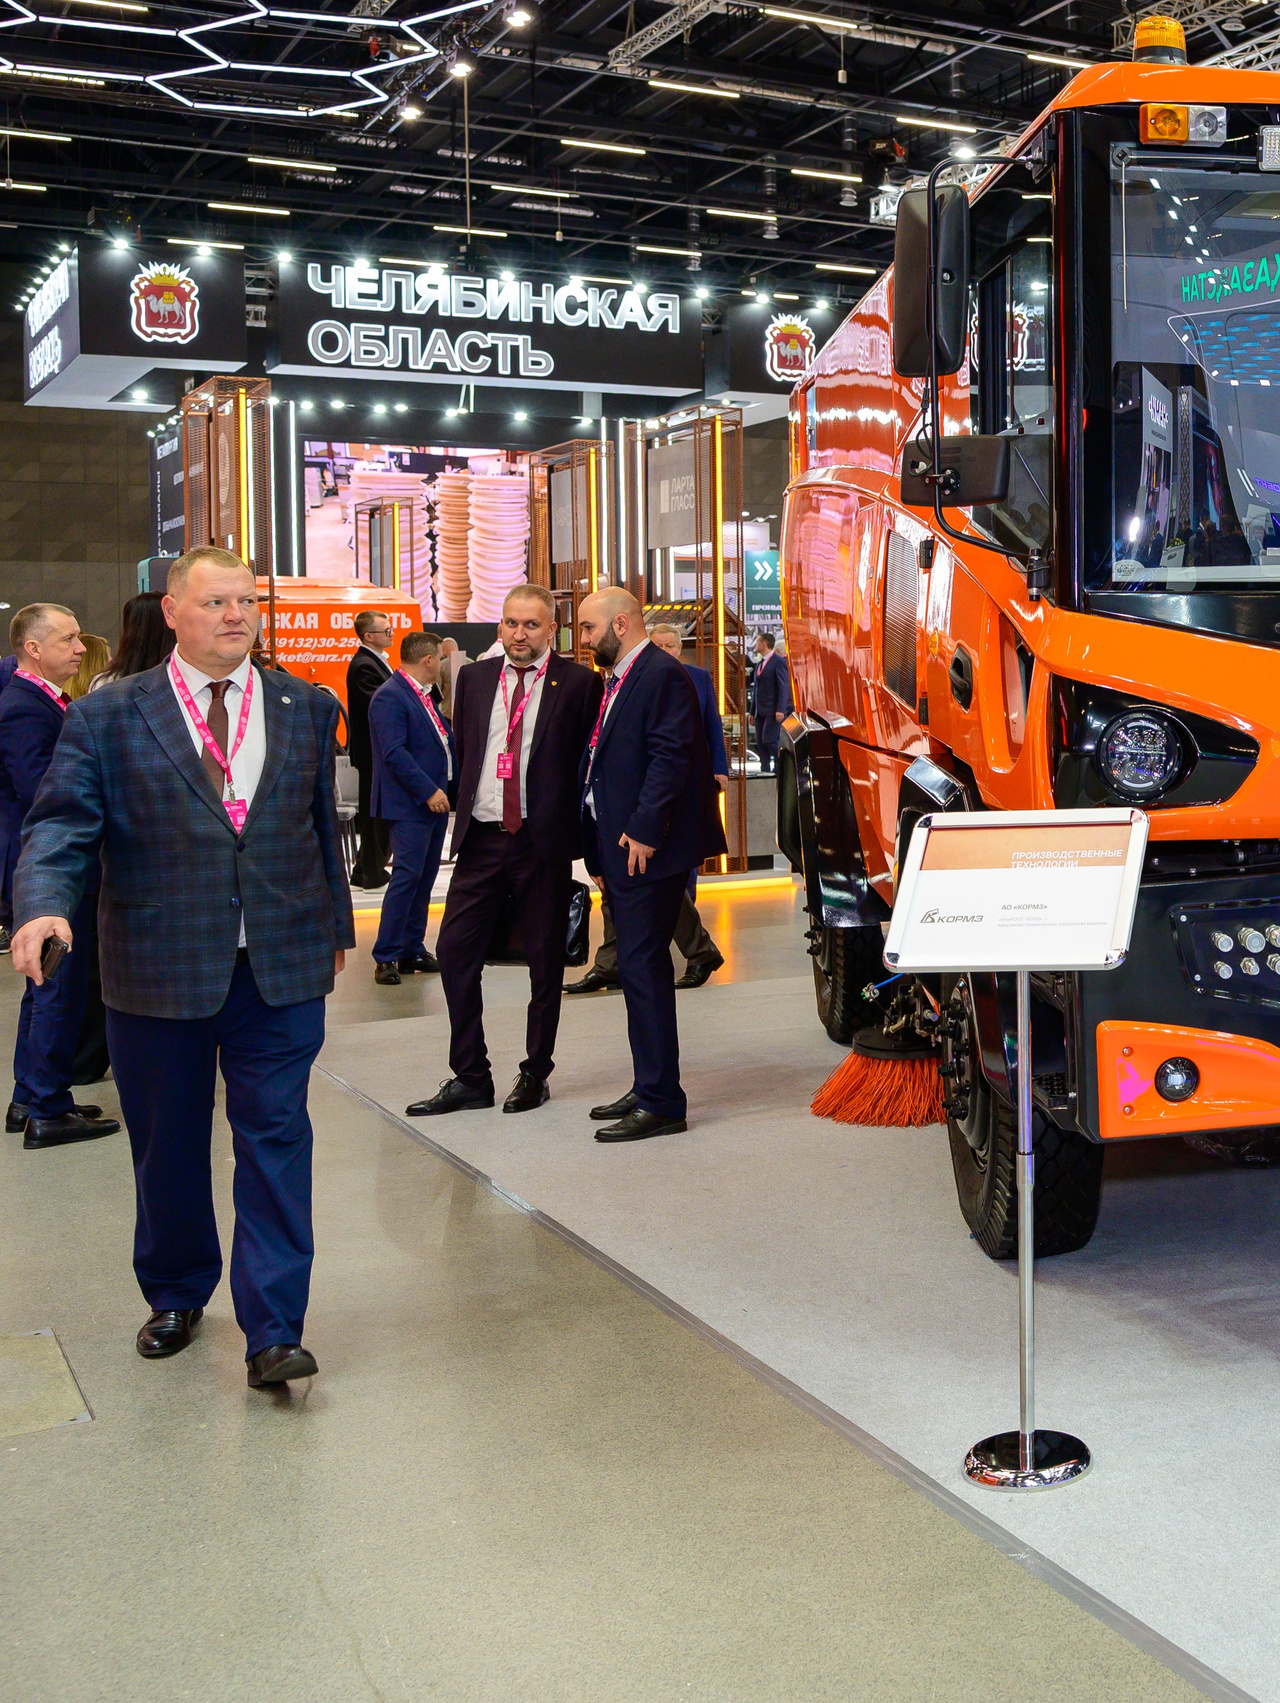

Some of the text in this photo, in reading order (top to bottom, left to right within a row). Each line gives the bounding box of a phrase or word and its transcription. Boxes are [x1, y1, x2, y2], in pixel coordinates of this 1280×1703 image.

[307, 263, 681, 334] ЧЕЛЯБИНСКАЯ
[307, 319, 555, 377] ОБЛАСТЬ
[670, 475, 696, 493] ЛАРТА
[1011, 849, 1123, 860] ПРОИЗВОДСТВЕННЫЕ
[1010, 859, 1079, 869] ТЕХНОЛОГИИ
[937, 915, 984, 923] КОРМЗ
